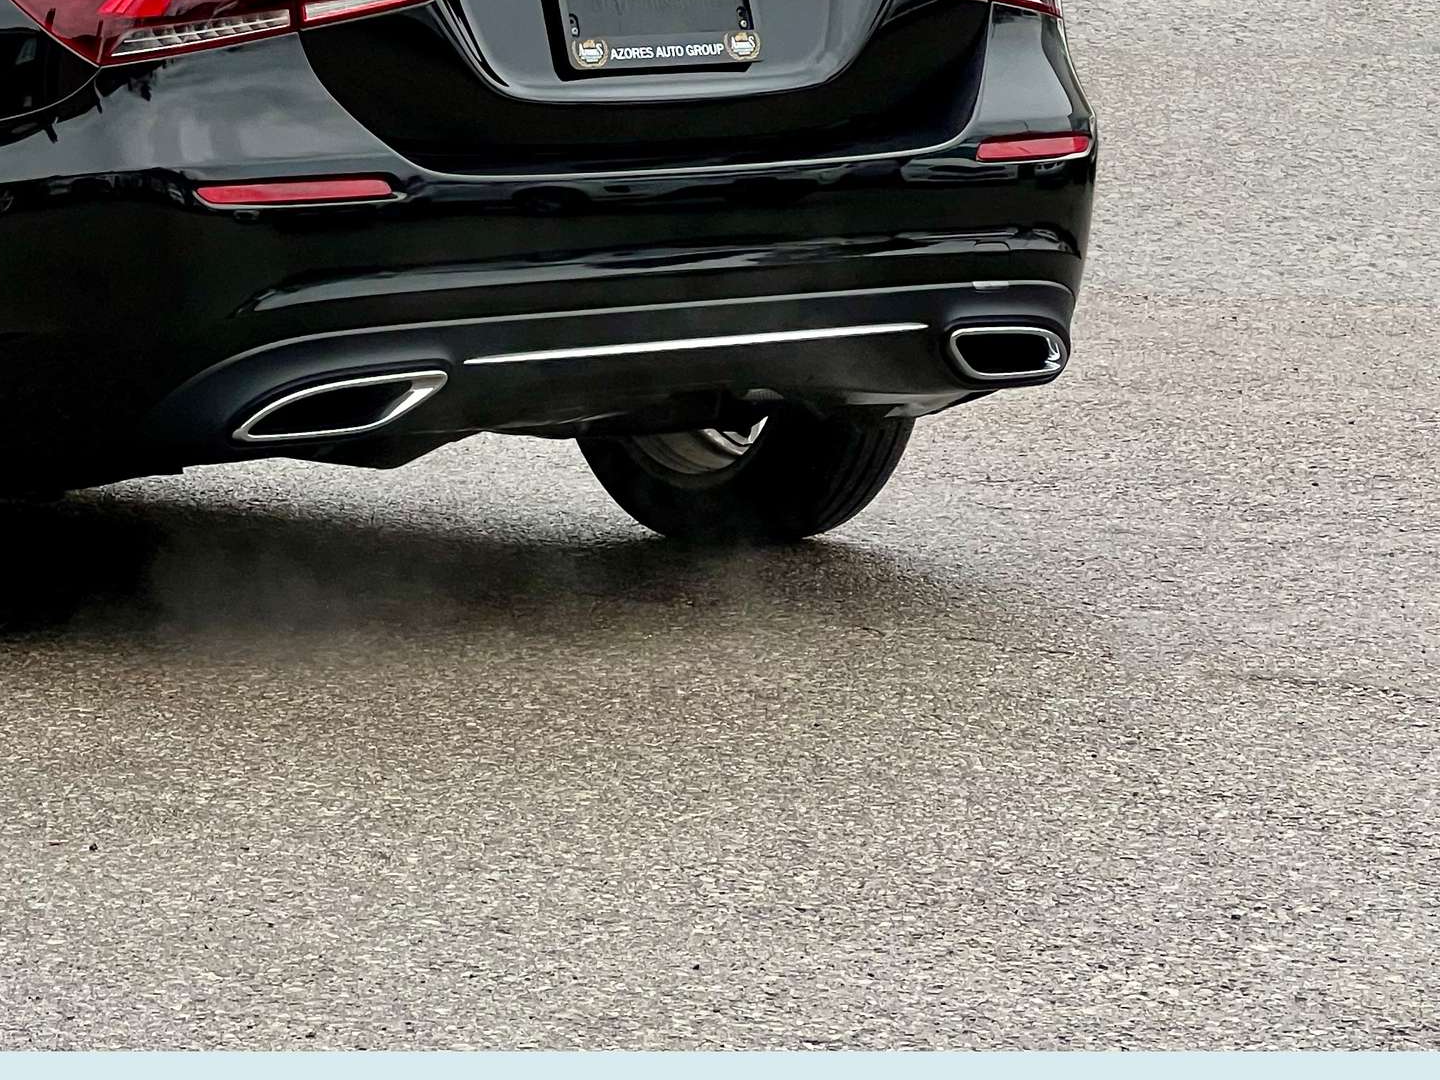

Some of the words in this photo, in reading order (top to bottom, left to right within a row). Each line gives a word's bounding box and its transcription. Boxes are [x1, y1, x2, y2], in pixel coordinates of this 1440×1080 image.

[610, 46, 655, 60] AZORES
[655, 44, 685, 58] AUTO
[686, 42, 726, 57] GROUP
